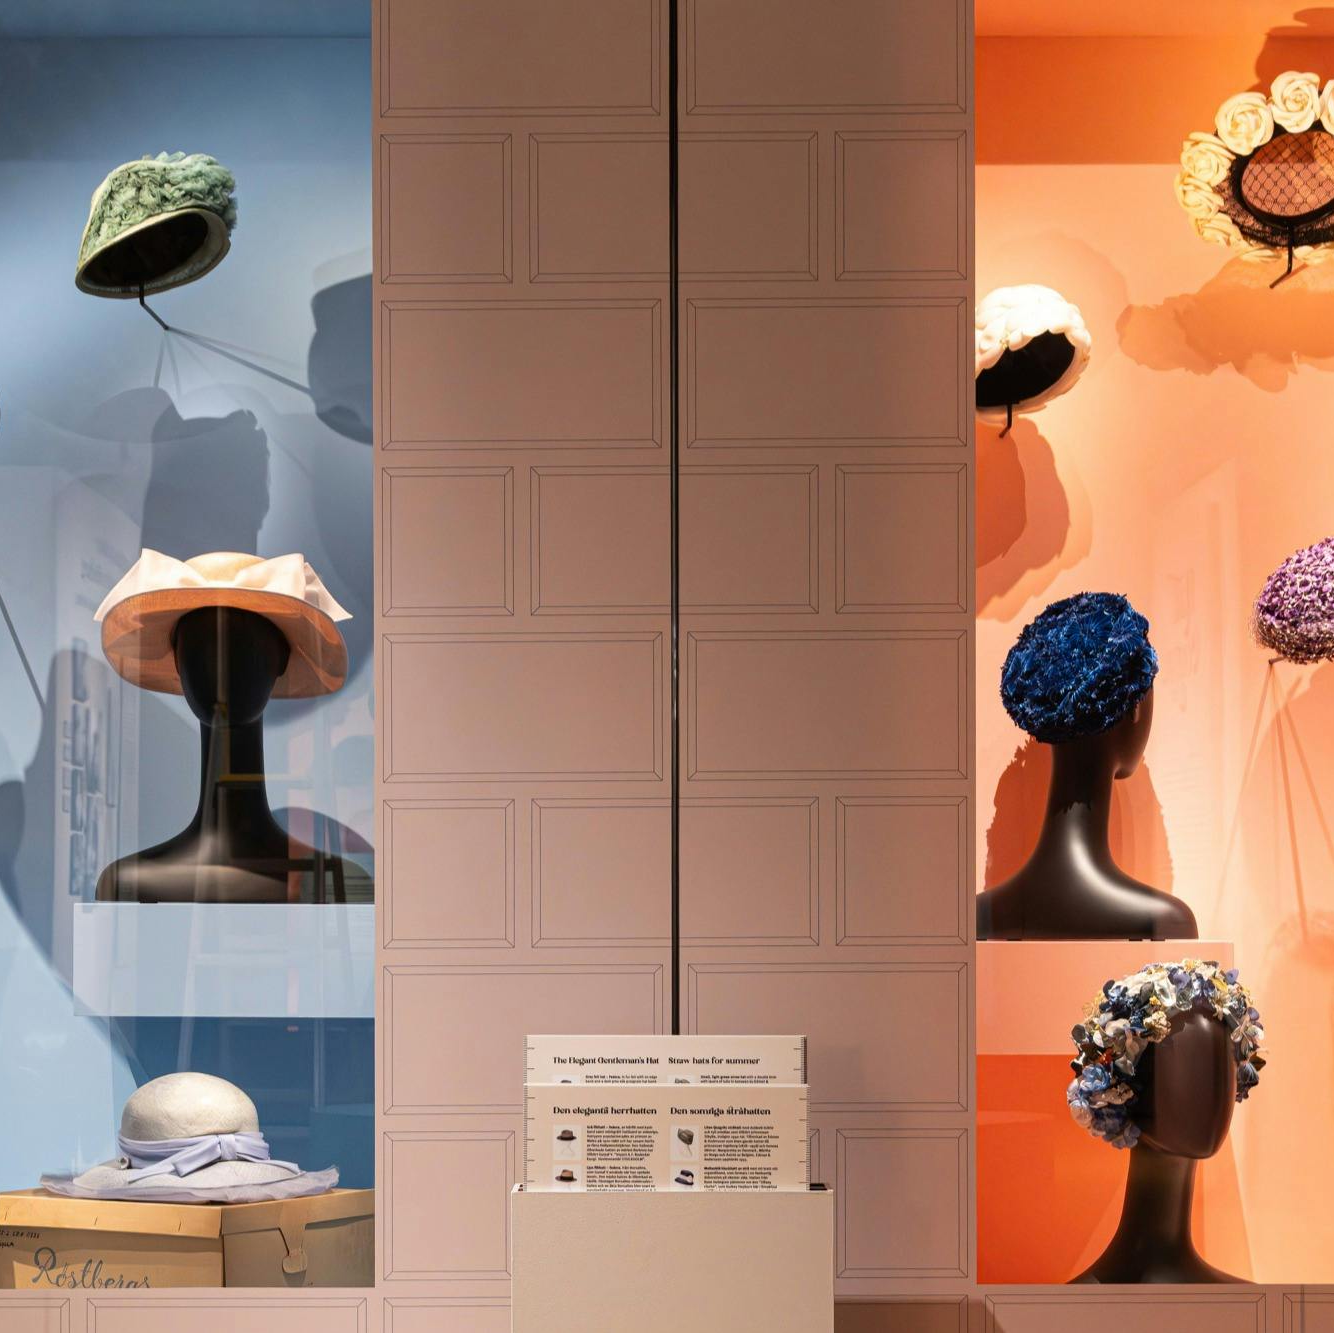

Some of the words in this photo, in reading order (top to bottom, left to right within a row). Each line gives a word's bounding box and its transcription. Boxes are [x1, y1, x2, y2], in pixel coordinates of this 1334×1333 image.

[553, 1056, 567, 1065] The
[568, 1056, 596, 1066] Elegant
[597, 1056, 644, 1065] Gentleman's
[646, 1056, 659, 1065] Hat
[668, 1056, 690, 1065] Straw
[692, 1056, 710, 1065] hats
[711, 1056, 723, 1065] for
[553, 1106, 571, 1115] Den
[572, 1106, 609, 1117] eleganta
[611, 1106, 657, 1115] herrhatten
[670, 1107, 688, 1115] Den
[689, 1107, 724, 1117] somriga
[726, 1106, 771, 1115] stråhatten
